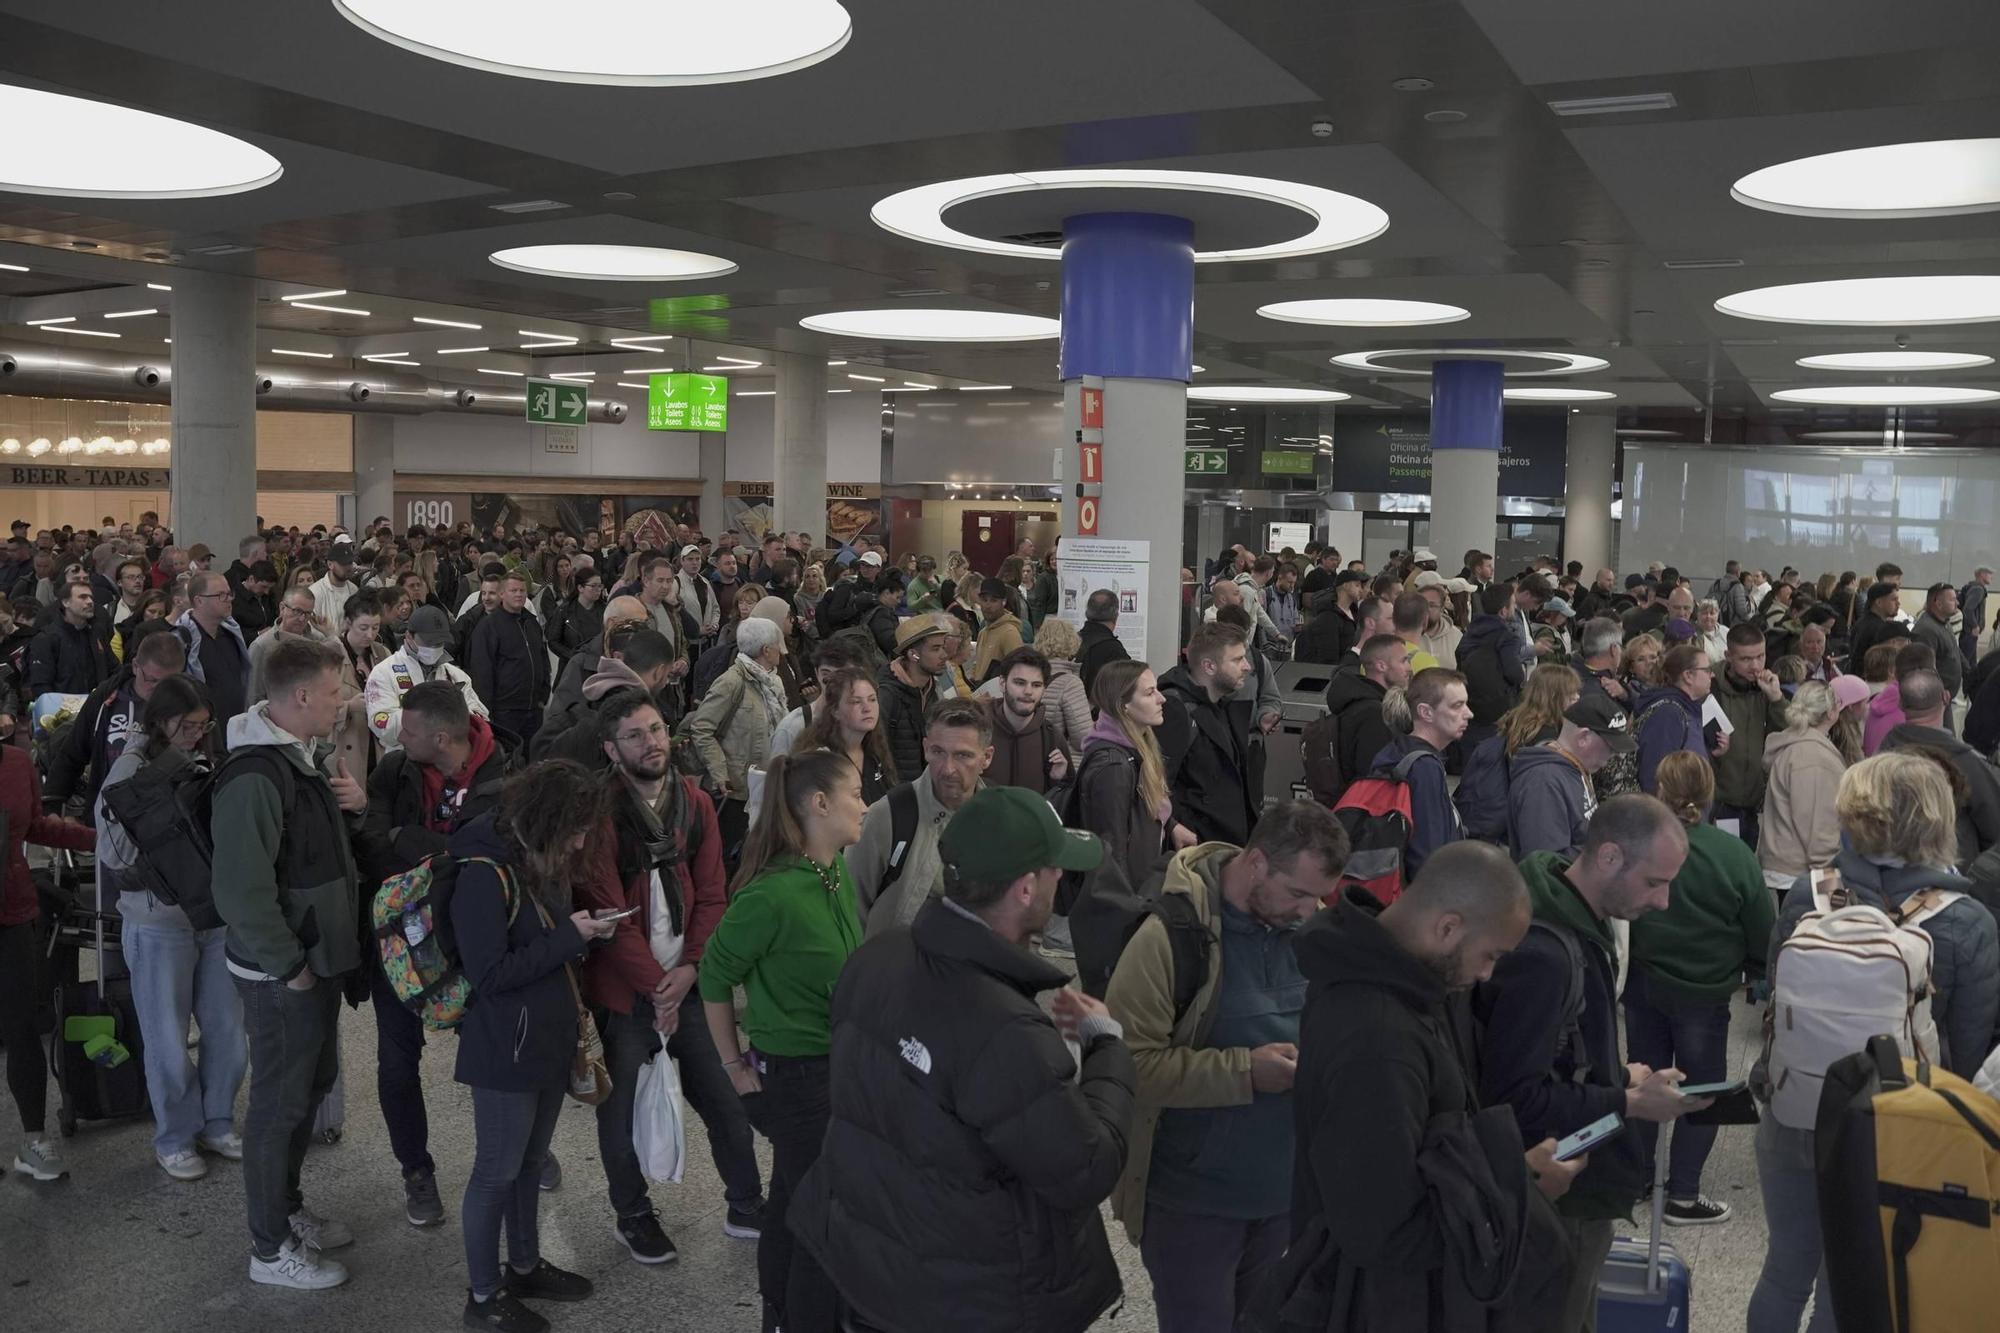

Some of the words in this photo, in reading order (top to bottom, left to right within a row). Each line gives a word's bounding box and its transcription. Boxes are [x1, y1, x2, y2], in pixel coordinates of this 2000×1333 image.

[665, 401, 688, 409] Lavabos
[705, 402, 726, 412] Lavabos
[665, 409, 684, 417] Toilets
[665, 418, 682, 426] Aseos
[705, 419, 721, 427] Aseos
[1391, 443, 1419, 452] Oficina
[1389, 455, 1420, 465] Oficina
[11, 467, 69, 485] BEER
[85, 468, 150, 486] TAPAS
[740, 484, 770, 495] BEER
[828, 485, 864, 496] WINE
[407, 500, 453, 529] 1890
[278, 1258, 306, 1279] N
